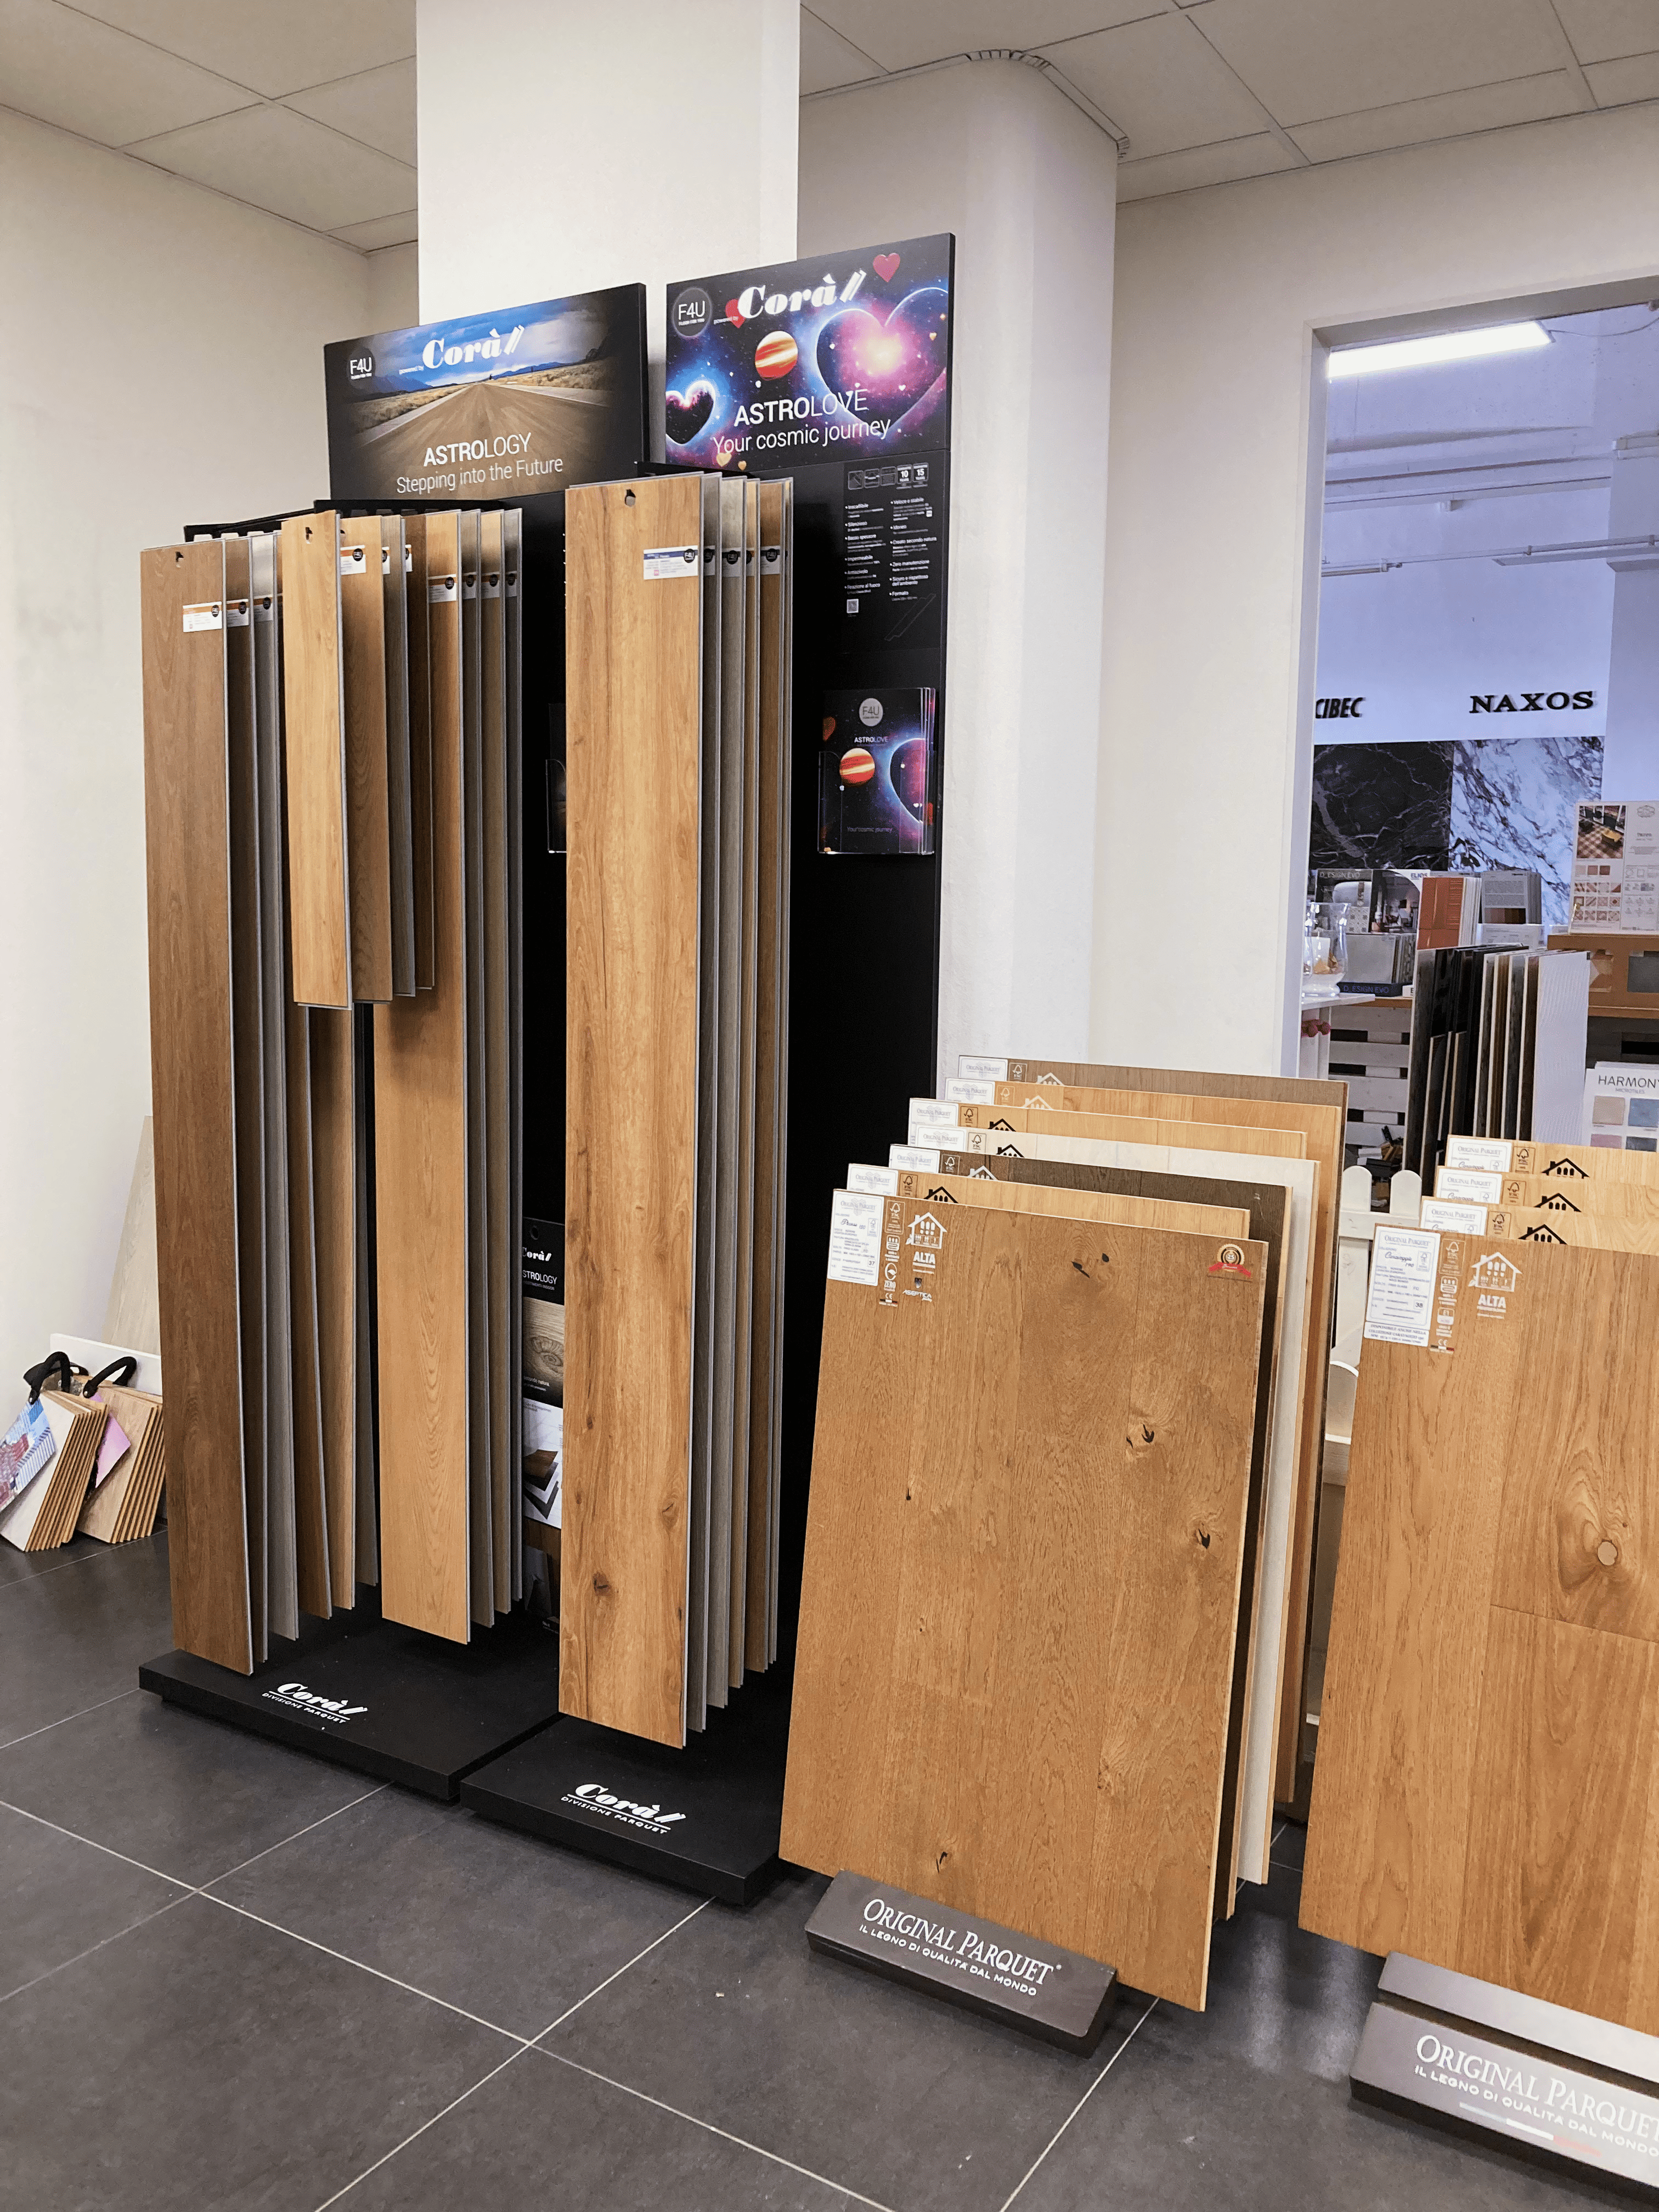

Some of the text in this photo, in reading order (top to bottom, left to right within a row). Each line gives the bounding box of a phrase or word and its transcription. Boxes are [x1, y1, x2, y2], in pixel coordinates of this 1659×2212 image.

[679, 301, 706, 320] F4U
[350, 357, 372, 375] F4U
[734, 389, 870, 427] ASTROLOVE
[423, 432, 532, 467] ASTROLOGY
[713, 419, 891, 455] Your cosmic journey
[396, 458, 563, 495] Stepping into the Future
[862, 706, 879, 715] F4U
[1469, 691, 1595, 713] NAXOS
[913, 1251, 936, 1264] ALTA
[523, 1270, 557, 1285] STROLOGY
[1477, 1294, 1506, 1308] ALTA
[262, 1692, 347, 1724] DIVISIONE PARQUET
[561, 1796, 668, 1834] DIVISIONE PARQUET
[863, 1898, 957, 1951] ORIGINAL
[859, 1924, 868, 1934] IL
[870, 1928, 907, 1948] LEGNO
[908, 1942, 921, 1953] DI
[969, 1965, 991, 1980] DAL
[994, 1973, 1037, 1996] MONDO
[1416, 2034, 1540, 2101] ORIGINAL
[1414, 2064, 1427, 2077] IL
[1430, 2070, 1480, 2096] LEGNO
[1483, 2089, 1498, 2103] DI
[1567, 2119, 1598, 2137] DAL
[1601, 2130, 1659, 2158] MONDO
